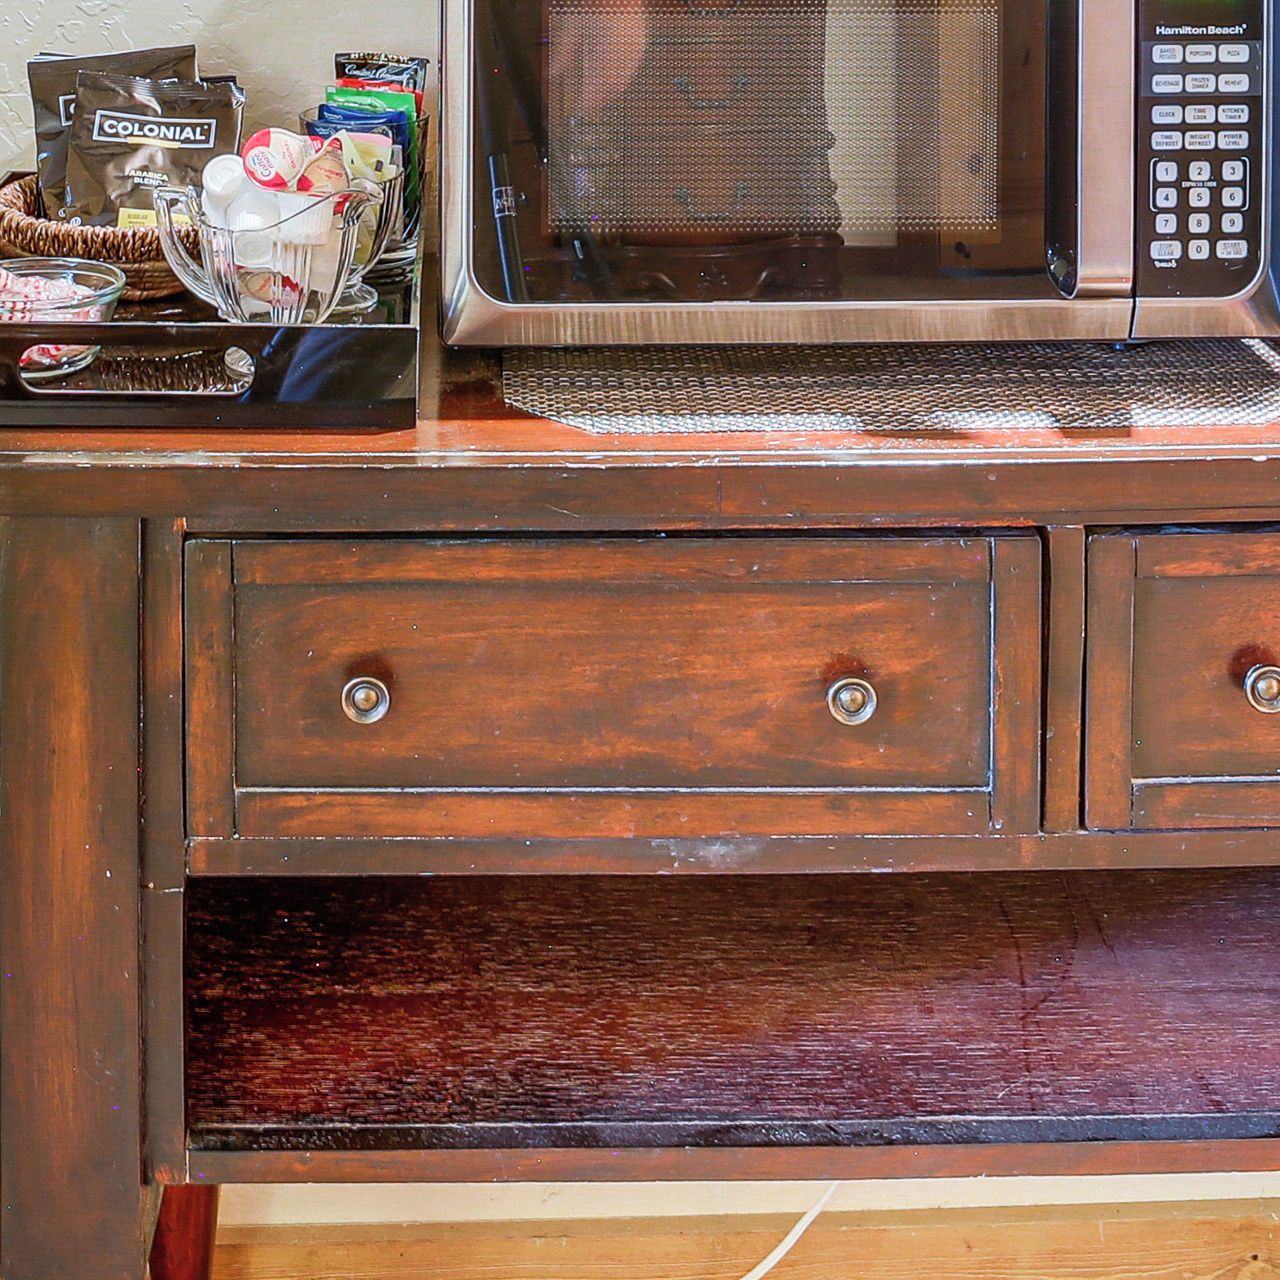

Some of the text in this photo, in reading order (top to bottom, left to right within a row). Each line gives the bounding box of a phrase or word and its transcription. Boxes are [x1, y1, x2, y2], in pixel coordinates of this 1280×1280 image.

[1156, 25, 1244, 35] Hamilton Beach
[102, 119, 206, 140] COLONIAL
[254, 153, 272, 178] Coffee
[129, 170, 169, 182] ARABICA
